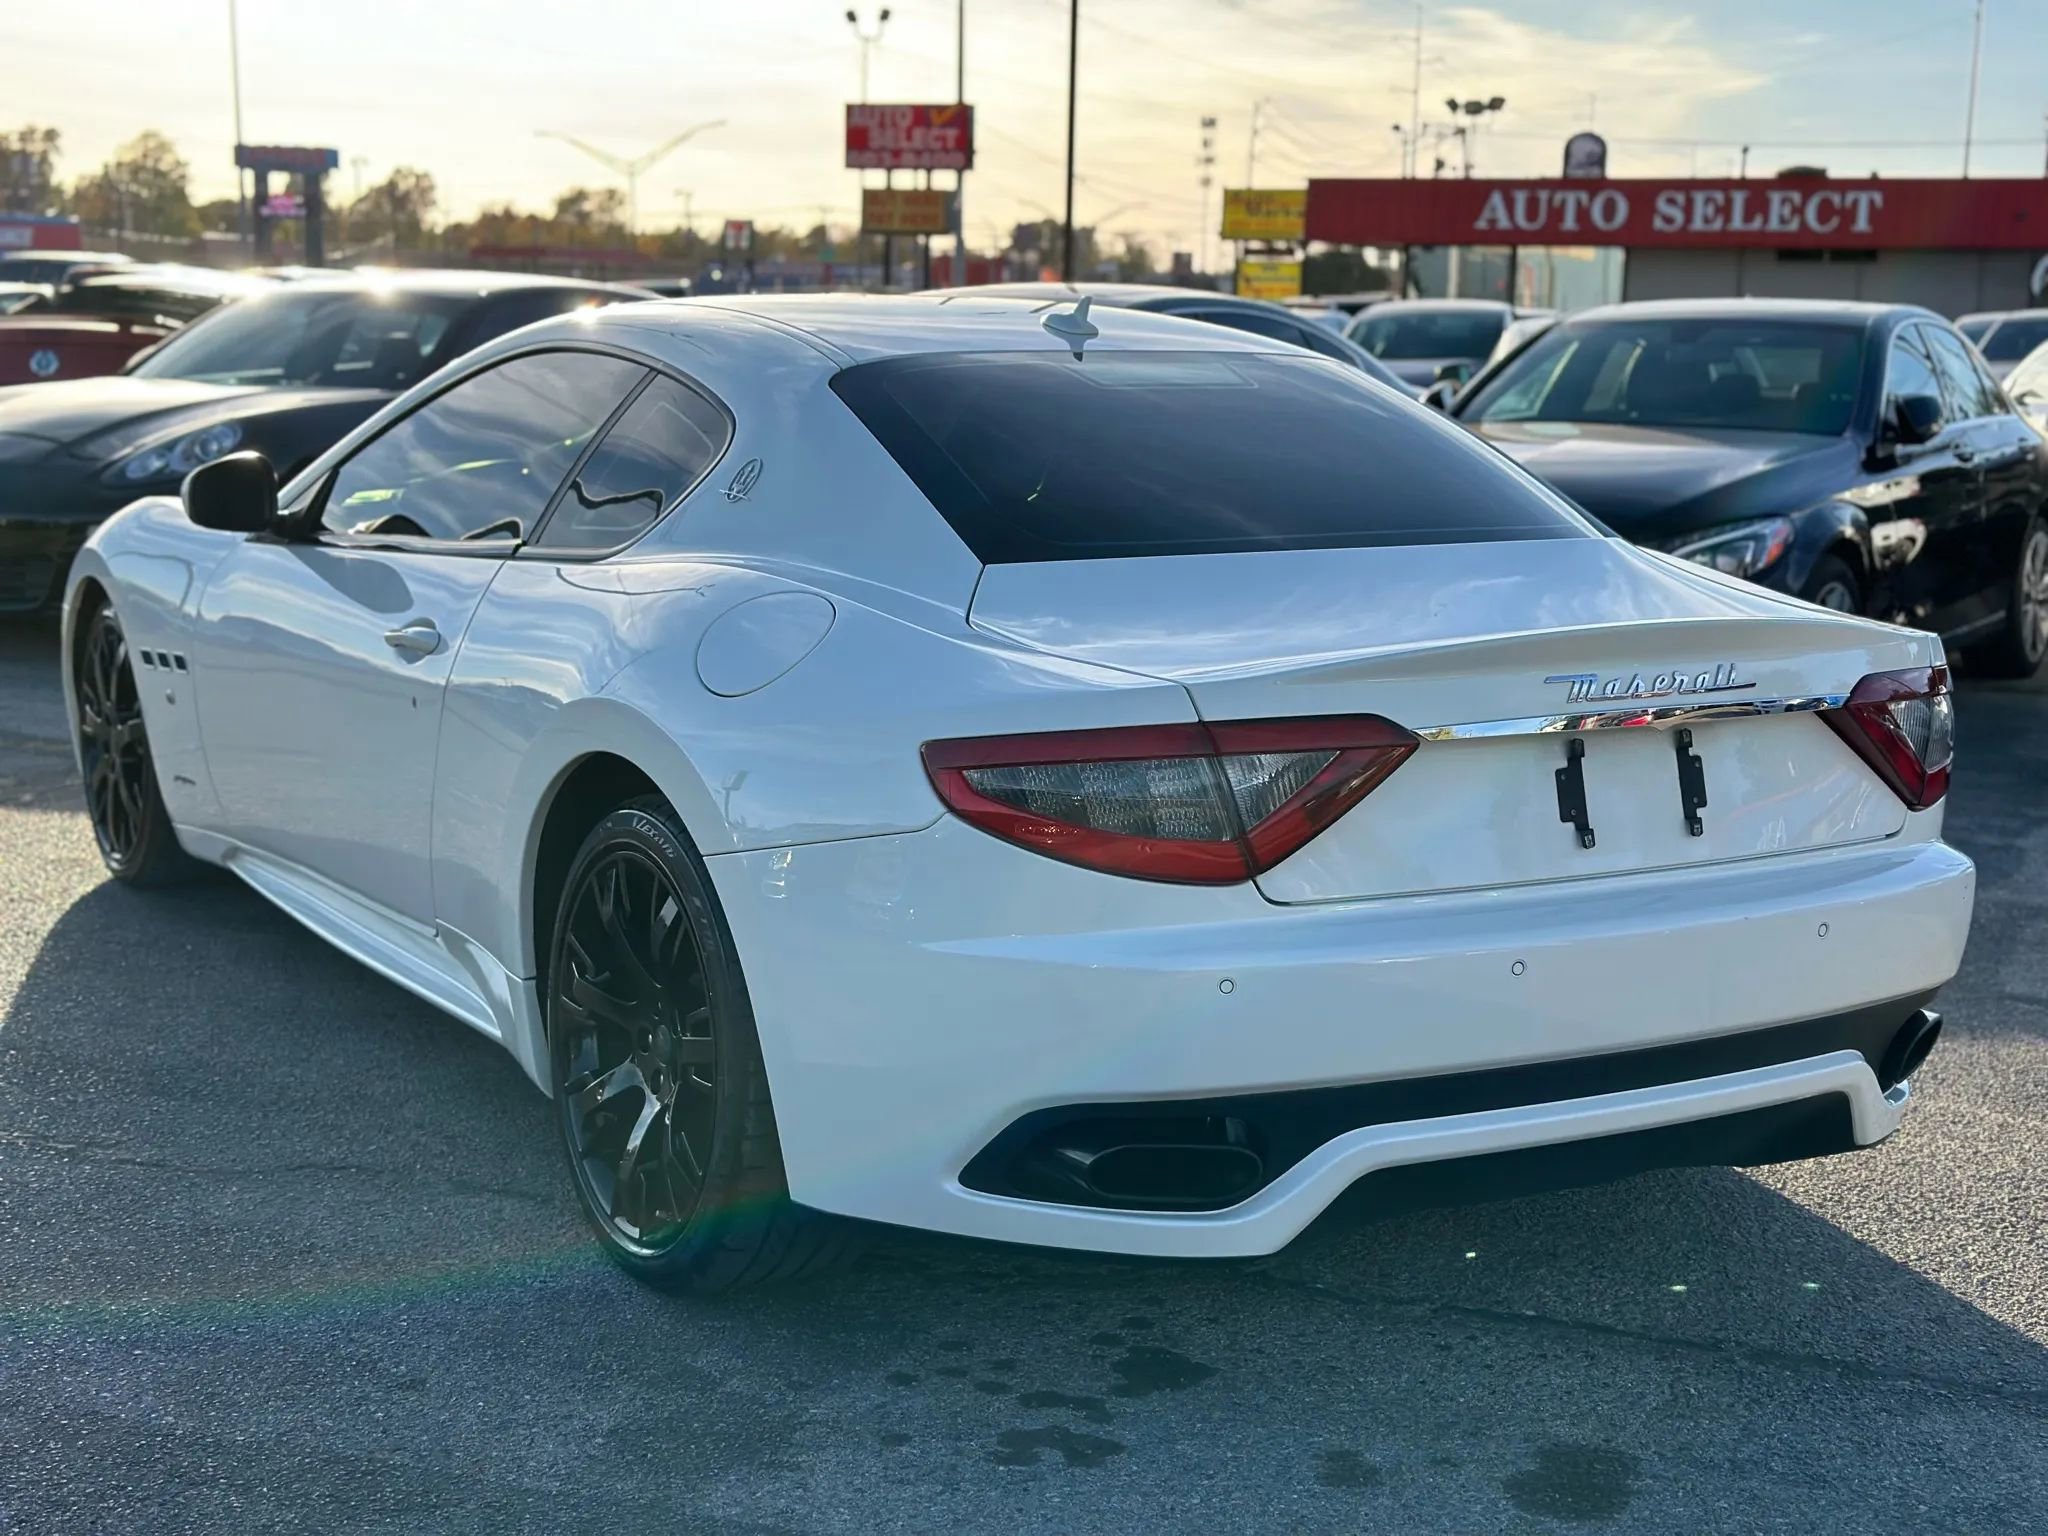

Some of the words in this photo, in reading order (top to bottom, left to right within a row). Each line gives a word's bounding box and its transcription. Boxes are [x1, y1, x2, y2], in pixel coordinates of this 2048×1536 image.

[849, 106, 914, 127] AUTO
[1473, 189, 1630, 231] AUTO
[1652, 190, 1883, 234] SELECT
